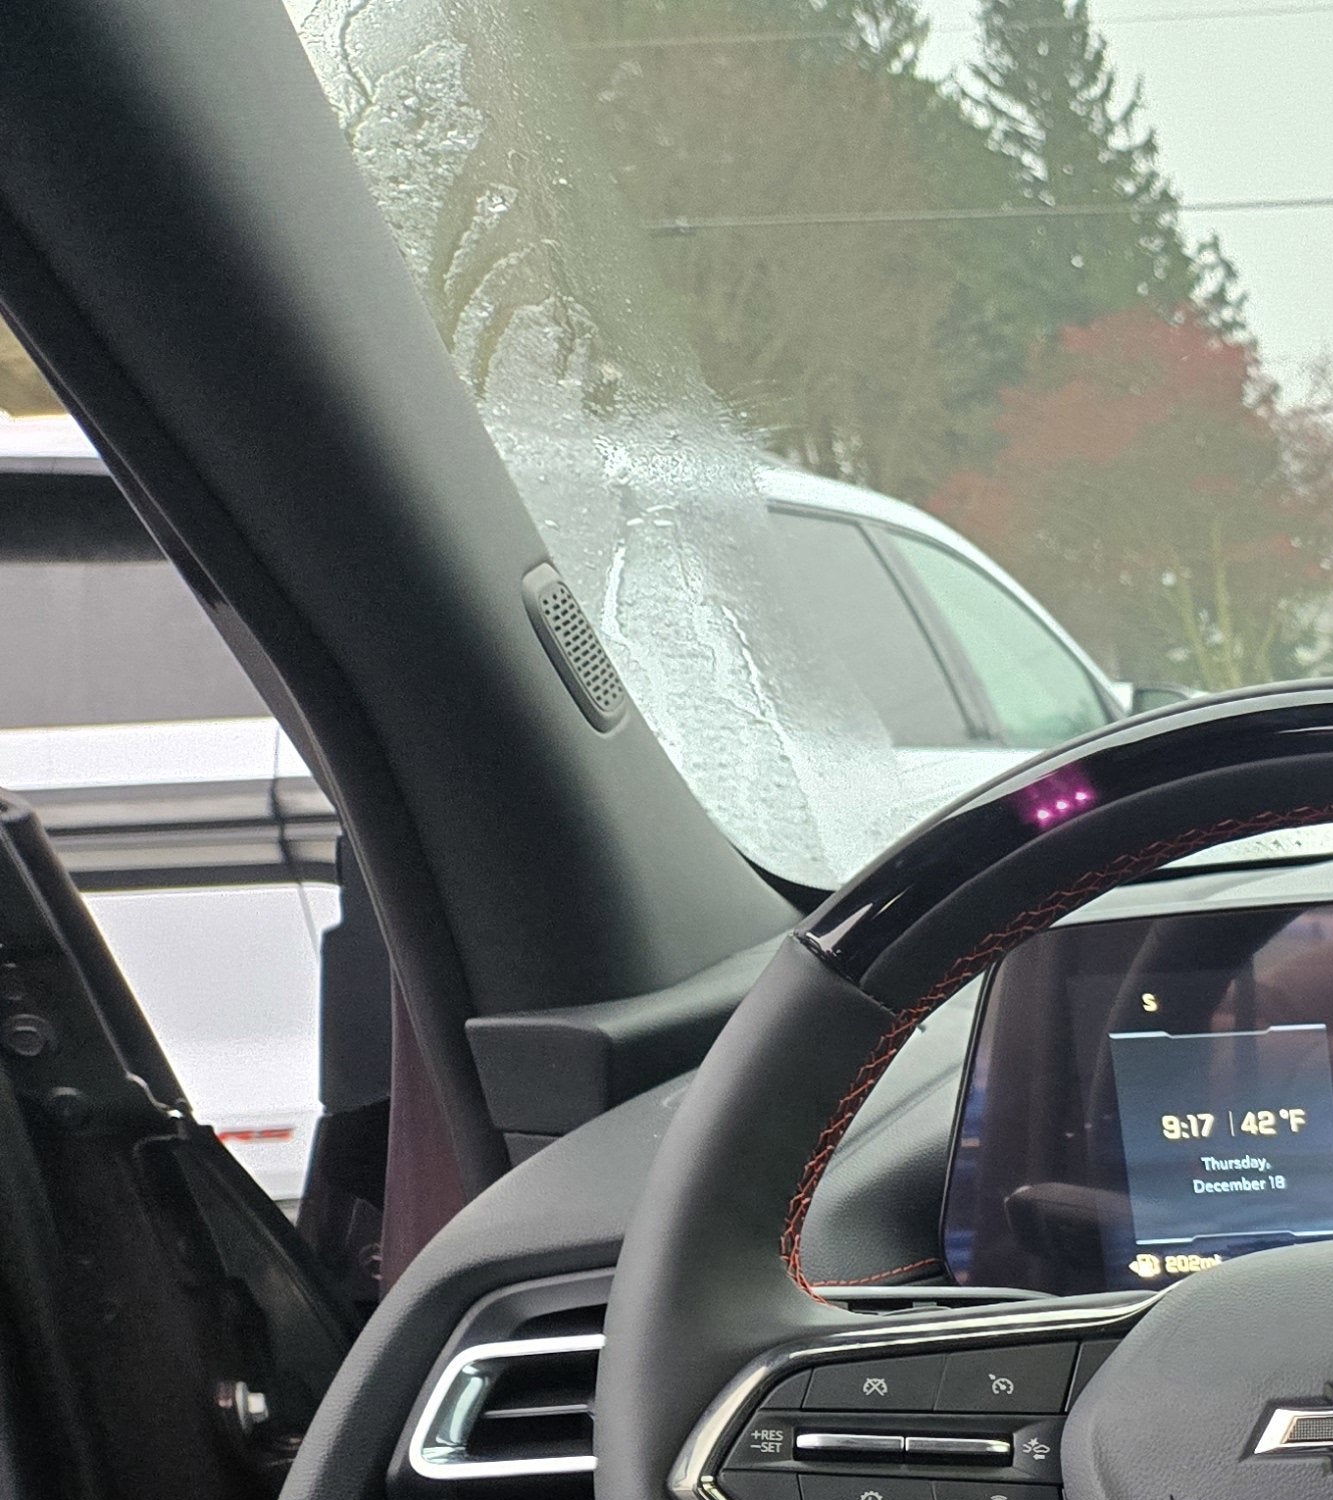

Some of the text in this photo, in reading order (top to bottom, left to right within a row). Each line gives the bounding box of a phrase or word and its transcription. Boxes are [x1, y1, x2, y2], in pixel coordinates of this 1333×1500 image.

[1142, 993, 1159, 1012] S
[1161, 1113, 1215, 1140] 9:17
[1193, 1175, 1286, 1195] December 18
